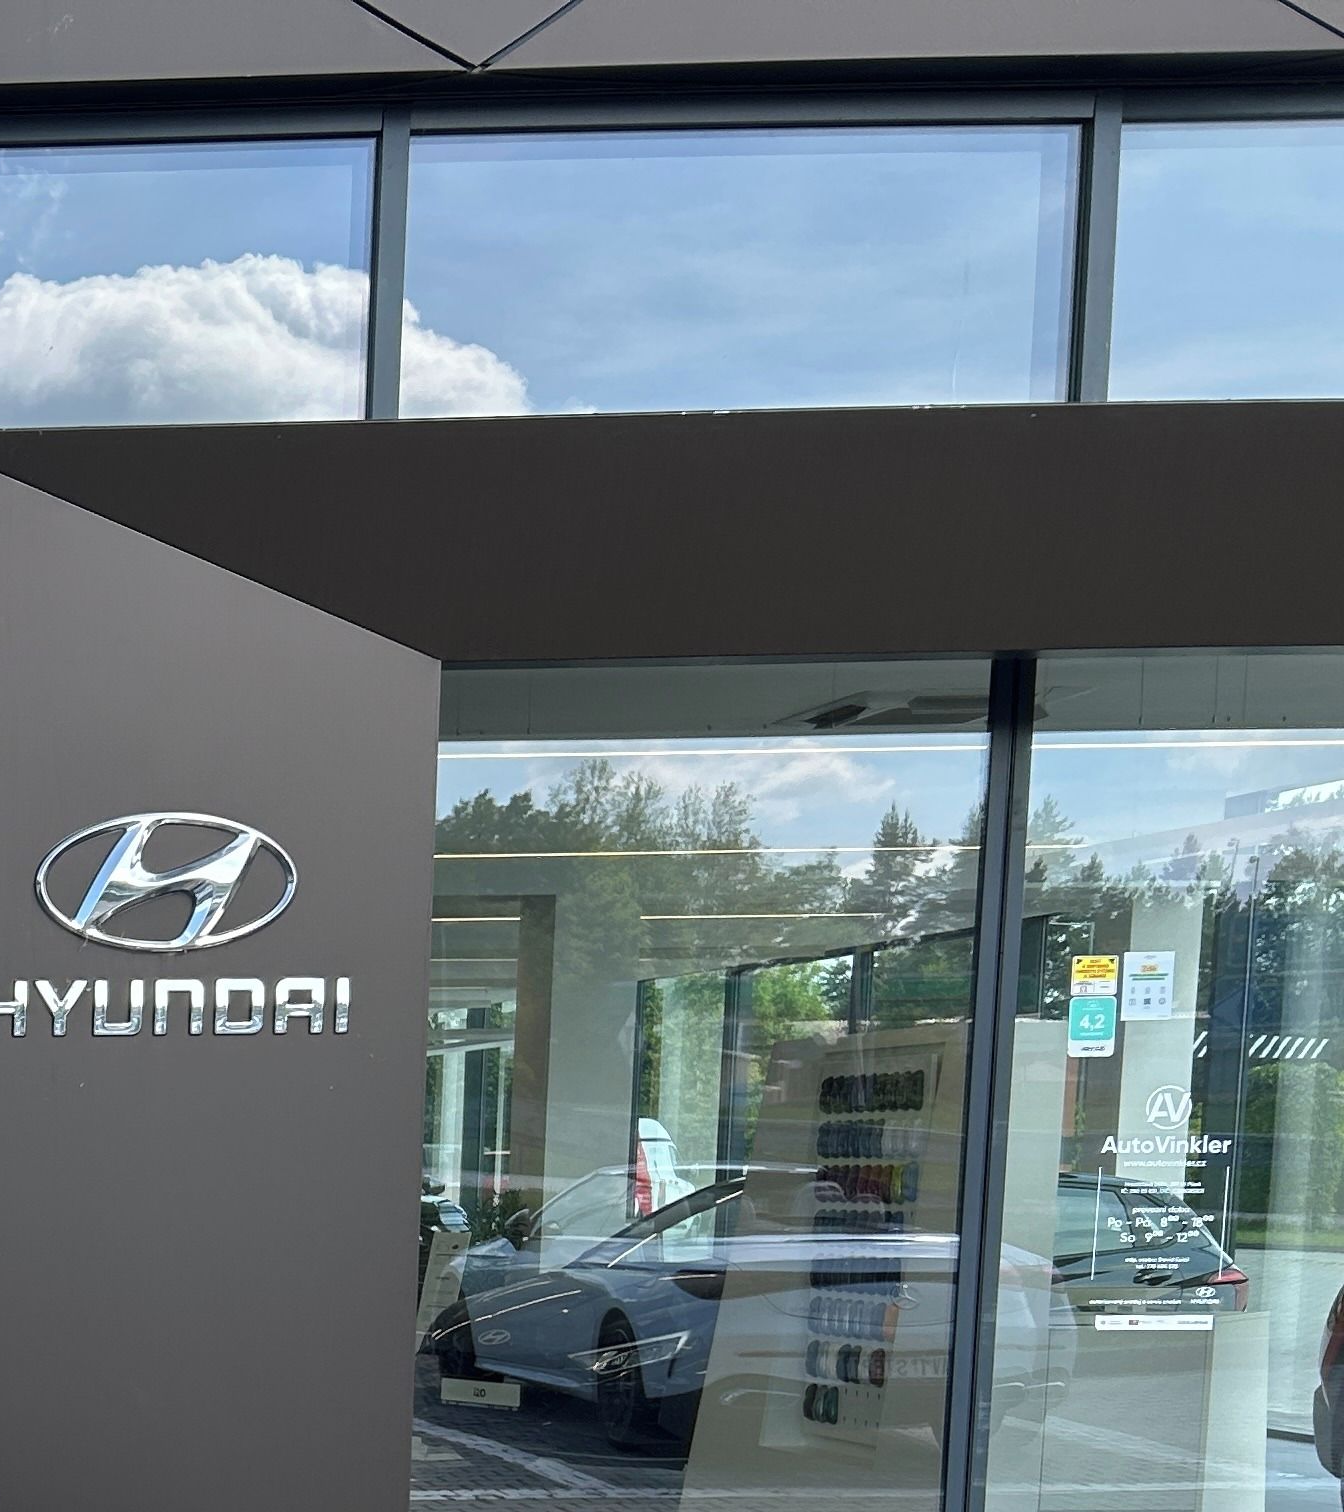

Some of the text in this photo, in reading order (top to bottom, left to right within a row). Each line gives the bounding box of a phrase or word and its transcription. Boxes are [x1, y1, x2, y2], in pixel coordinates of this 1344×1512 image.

[1079, 1013, 1105, 1032] 4,2
[1146, 1092, 1192, 1123] AV
[1100, 1134, 1232, 1154] AutoVinkler
[1107, 1217, 1123, 1228] Po
[1119, 1232, 1136, 1243] So
